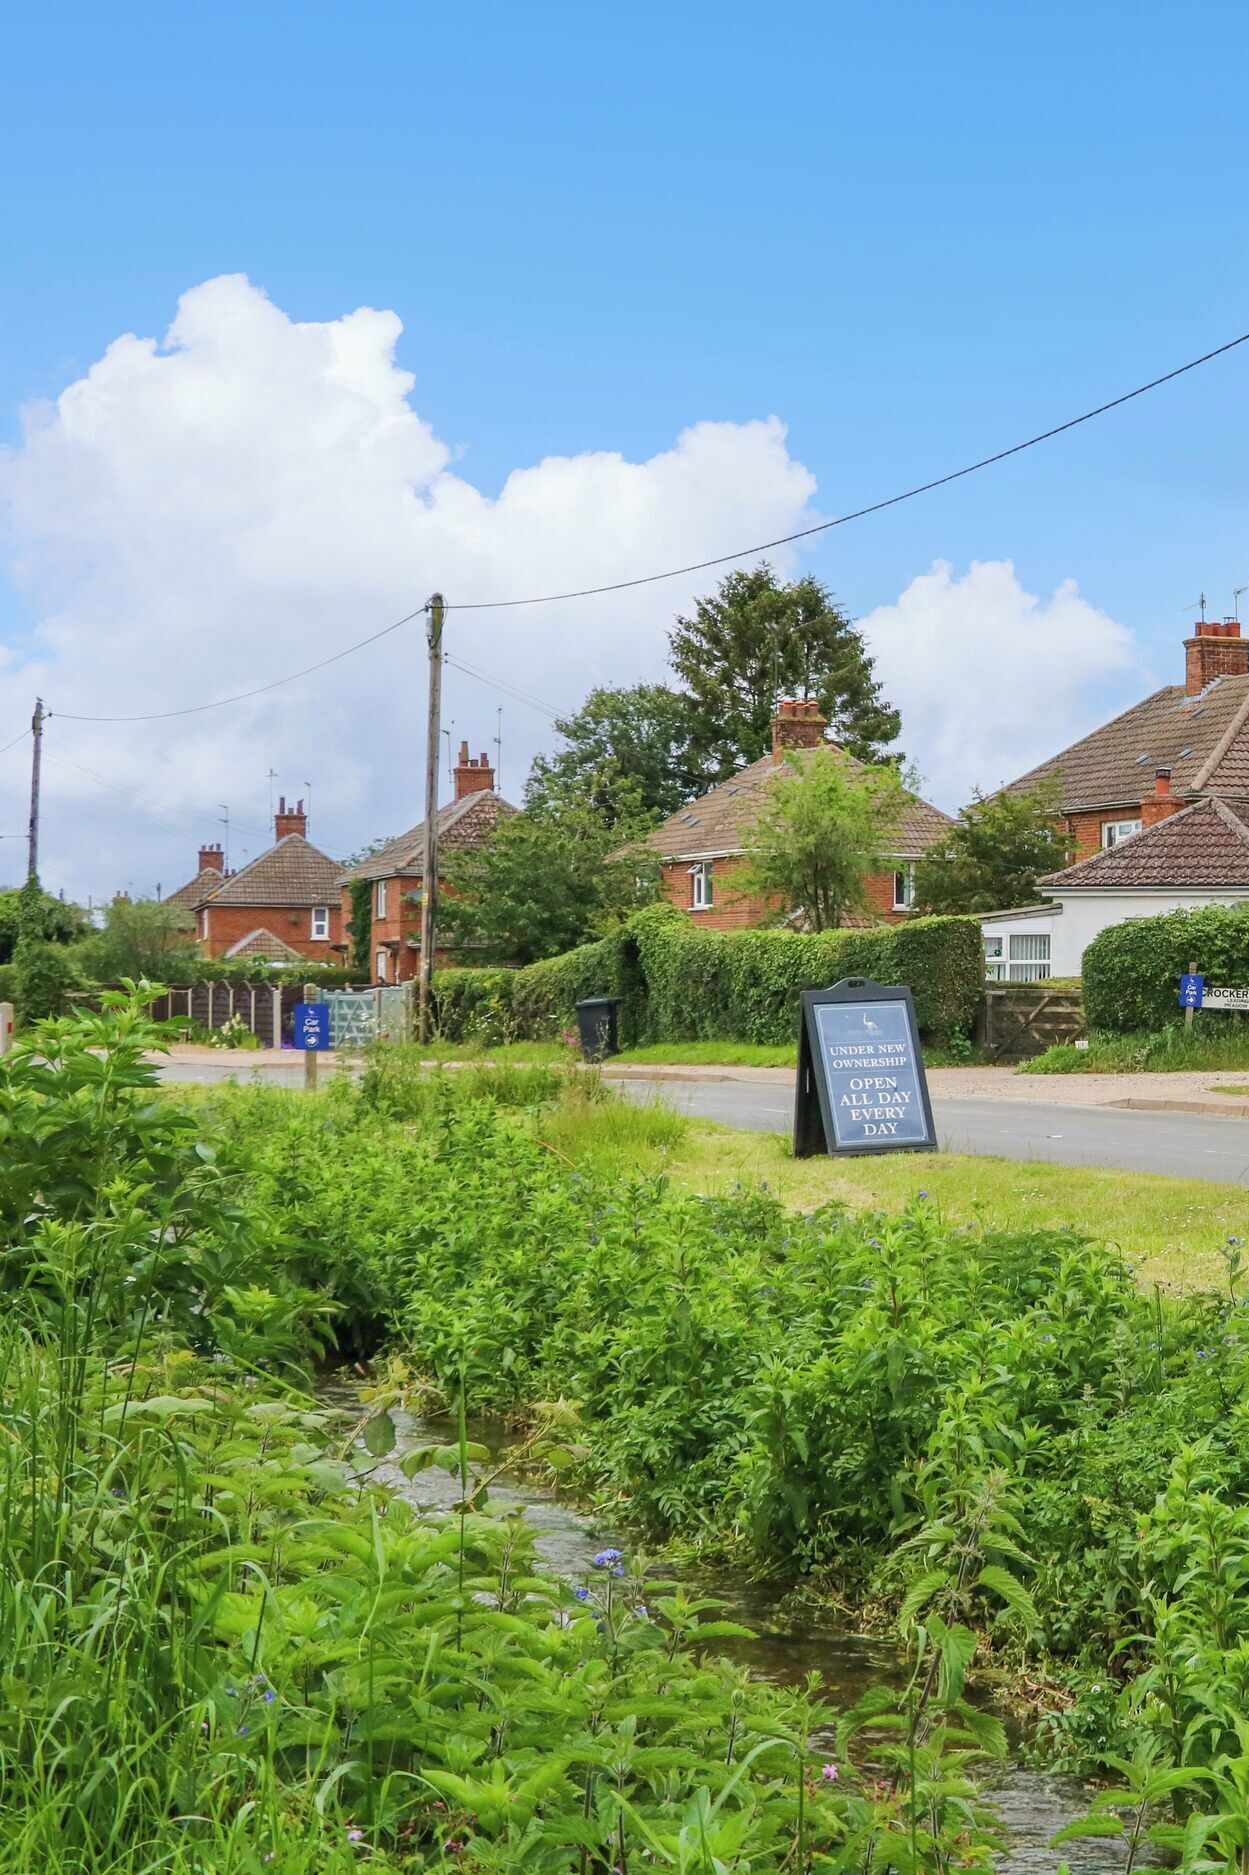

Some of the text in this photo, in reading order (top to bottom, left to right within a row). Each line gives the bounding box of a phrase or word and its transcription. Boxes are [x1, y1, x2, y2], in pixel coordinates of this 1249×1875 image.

[830, 1043, 906, 1056] UNDER NEW
[833, 1056, 907, 1069] OWNERSHIP
[849, 1076, 897, 1090] OPEN
[840, 1091, 912, 1106] ALL DAY
[850, 1106, 906, 1121] EVERY
[863, 1122, 898, 1136] DAY
